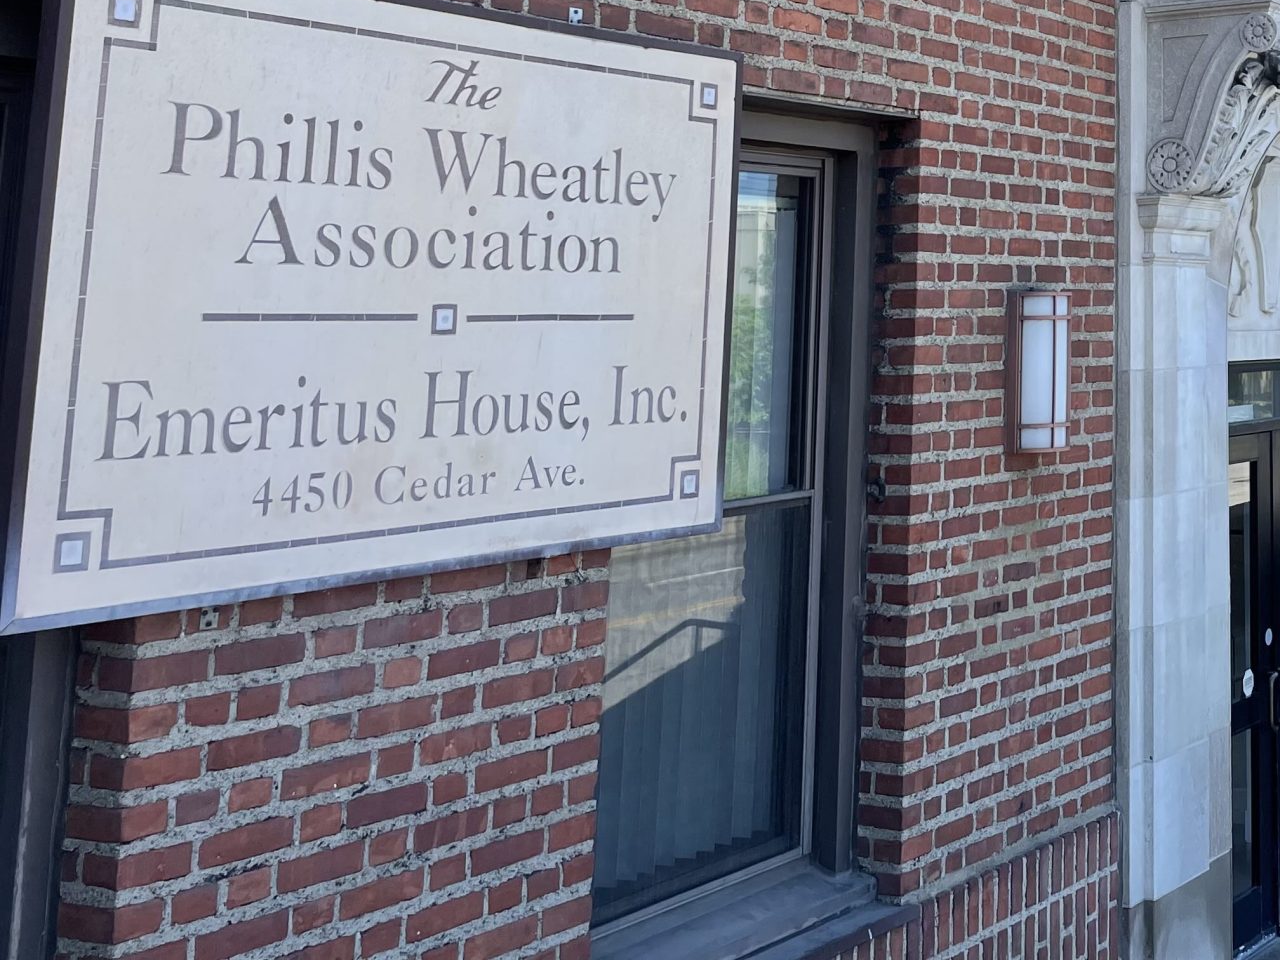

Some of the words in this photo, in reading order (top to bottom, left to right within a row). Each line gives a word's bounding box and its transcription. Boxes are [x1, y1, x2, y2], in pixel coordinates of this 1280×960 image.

[424, 59, 502, 111] The
[160, 100, 394, 191] Phillis
[423, 127, 678, 223] Wheatley
[235, 196, 622, 274] Association
[94, 376, 398, 461] Emeritus
[423, 369, 590, 442] House,
[608, 365, 688, 427] Inc.
[252, 469, 354, 517] 4450
[374, 462, 497, 506] Cedar
[514, 455, 586, 492] Ave.
